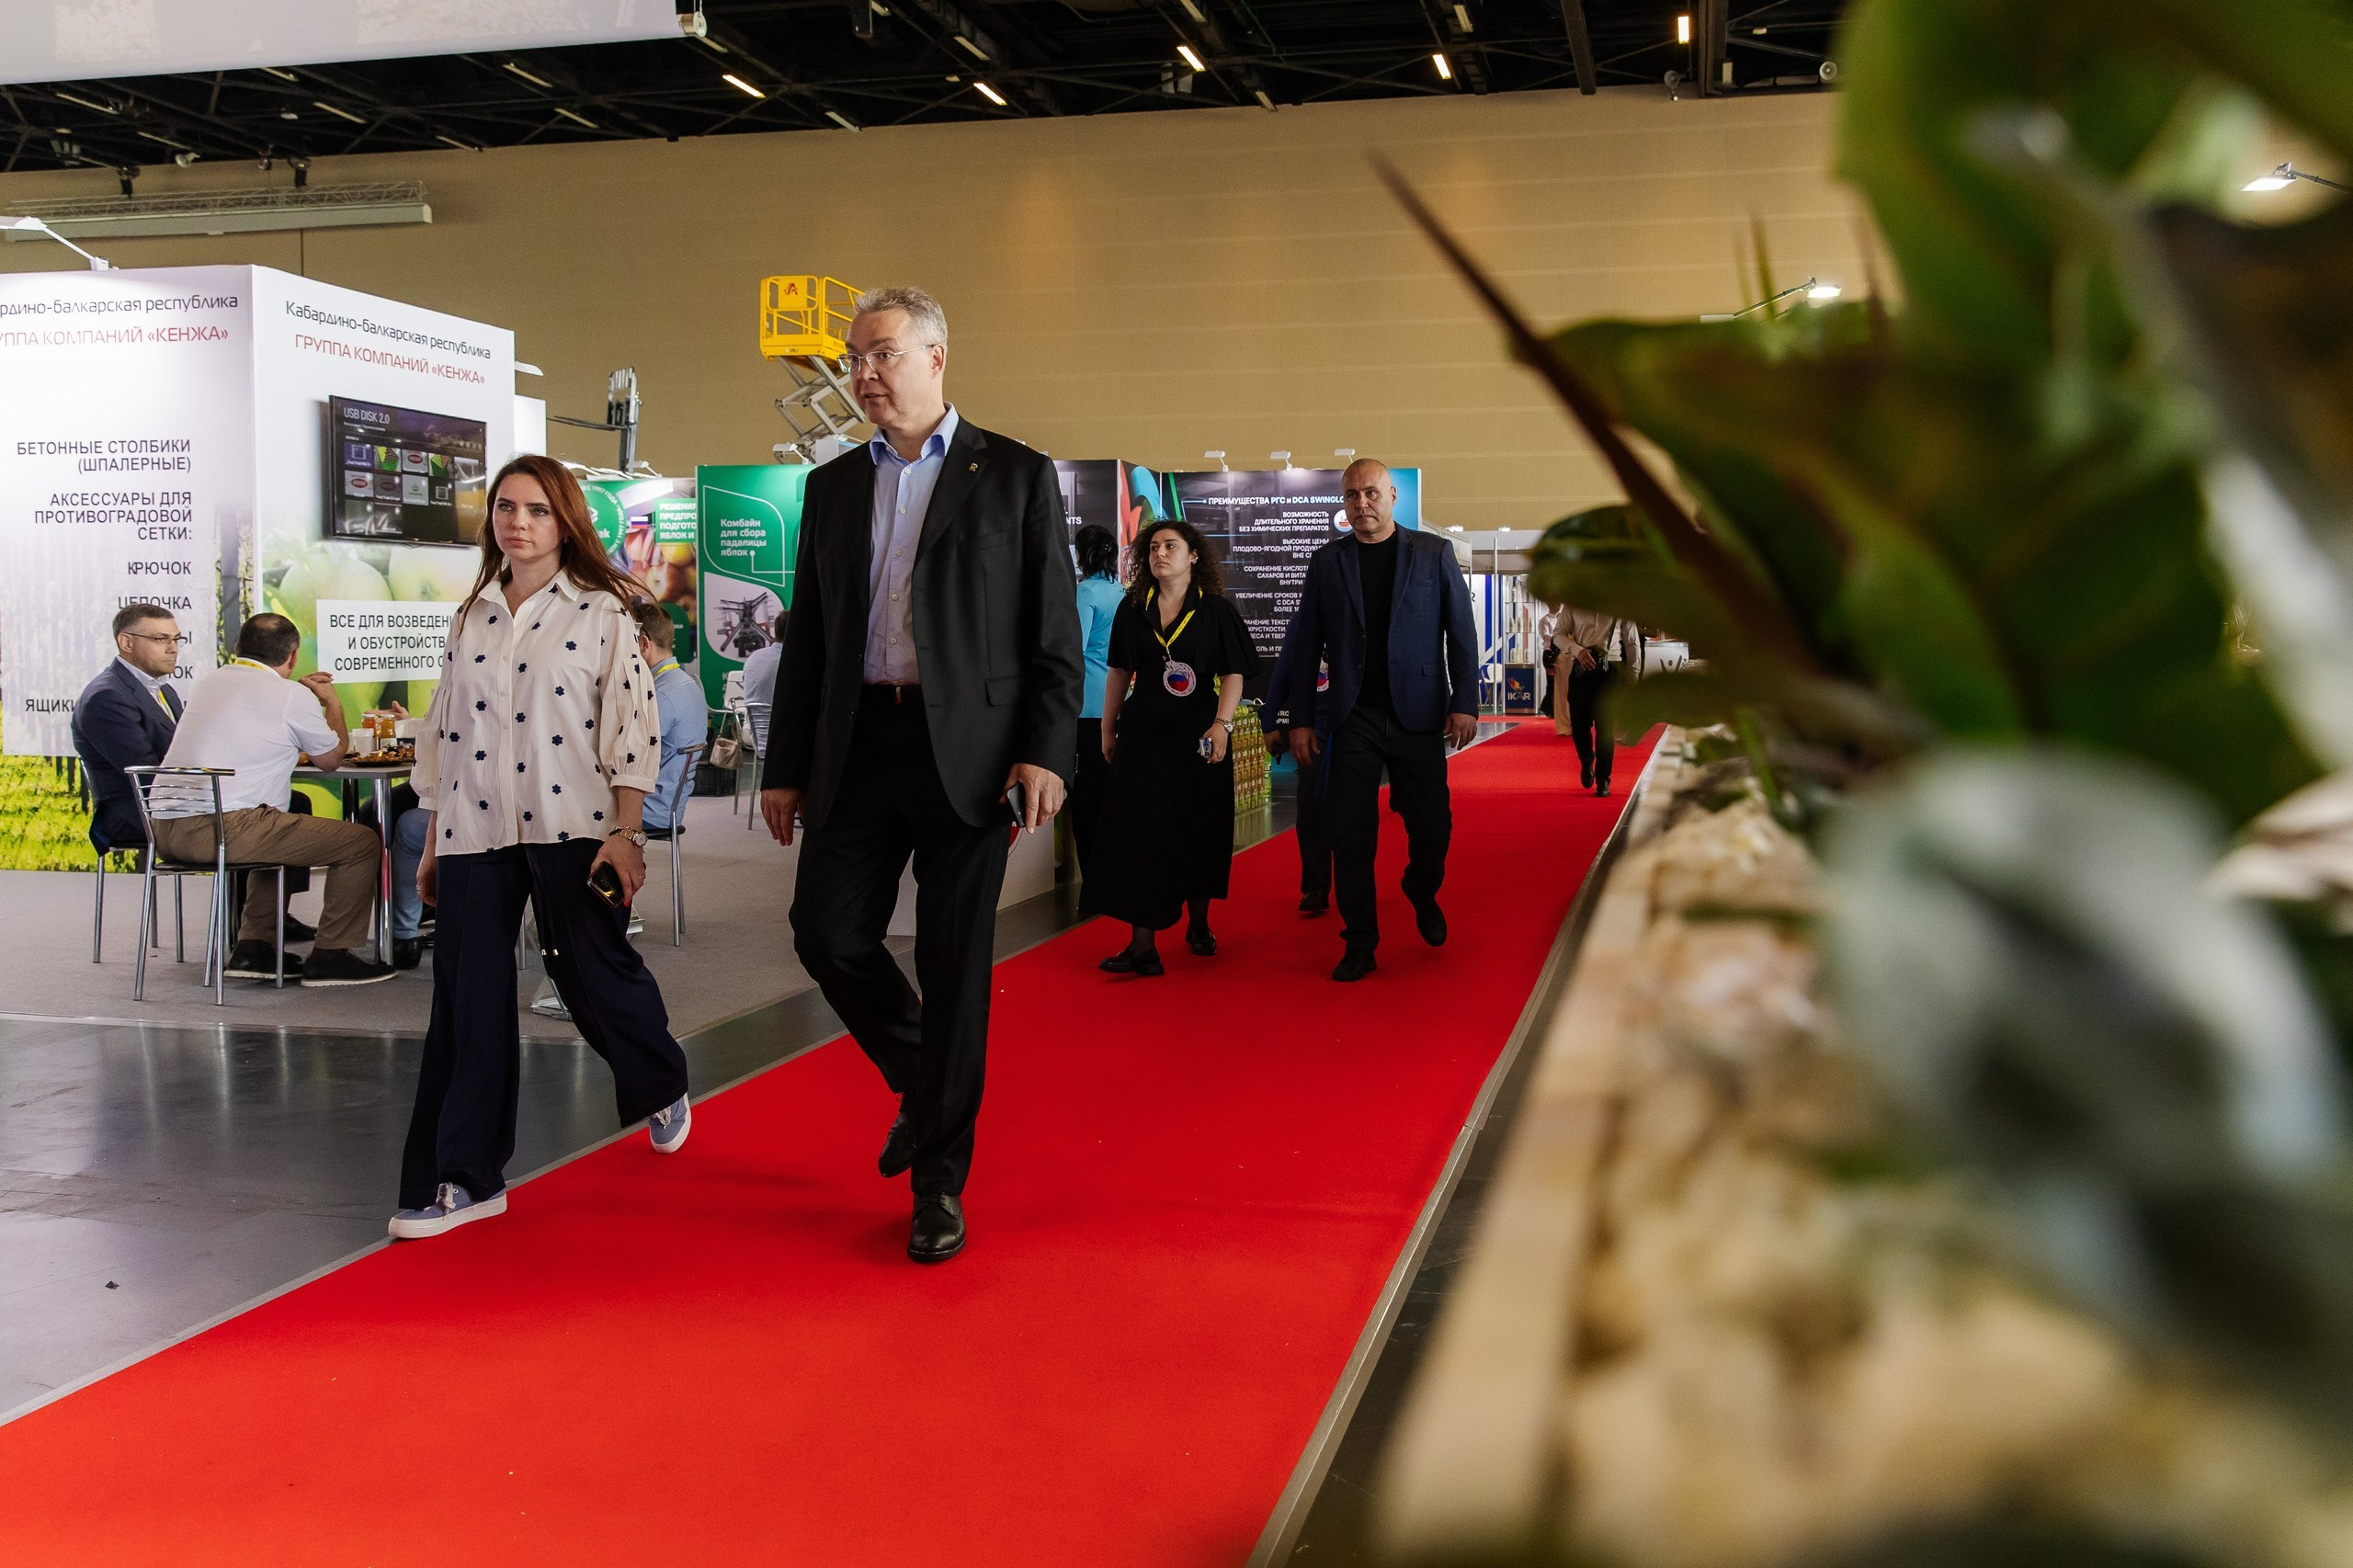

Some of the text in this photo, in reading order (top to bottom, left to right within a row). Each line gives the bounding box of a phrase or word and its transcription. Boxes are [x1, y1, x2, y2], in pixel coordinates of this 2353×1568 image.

[0, 294, 239, 318] рдино-балкарская республика
[0, 324, 230, 347] ППА КОМПАНИЙ «КЕНЖА»
[286, 301, 491, 359] Кабардино-балкарская республика
[295, 334, 485, 384] ГРУППА КОМПАНИЙ «КЕНЖА»
[343, 407, 391, 425] USB DISK 2.0
[17, 439, 191, 455] БЕТОННЫЕ СТОЛБИКИ
[78, 456, 192, 475] (ШПАЛЕРНЫЕ)
[50, 492, 192, 507] АКСЕССУАРЫ ДЛЯ
[1208, 496, 1269, 506] ПРЕИМУЩЕСТВА
[1270, 496, 1286, 505] РГС
[1291, 496, 1310, 505] DCA
[34, 506, 192, 525] ПРОТИВОГРАДОВОЙ
[659, 512, 696, 521] ПРЕДПРО
[720, 518, 761, 528] Комбайн
[659, 521, 696, 530] ПОДГОТО
[138, 527, 193, 540] СЕТКИ:
[659, 531, 687, 540] ЯБЛОК
[720, 528, 767, 539] для сбора
[720, 540, 767, 548] падалицы
[721, 547, 748, 557] яблок
[128, 561, 192, 575] КРЮЧОК
[330, 614, 452, 631] ВСЕ ДЛЯ ВОЗВЕДЕН
[347, 632, 446, 650] И ОБУСТРОЙСТВ
[335, 655, 435, 671] СОВРЕМЕННОГО
[25, 699, 76, 714] ЯЩИК
